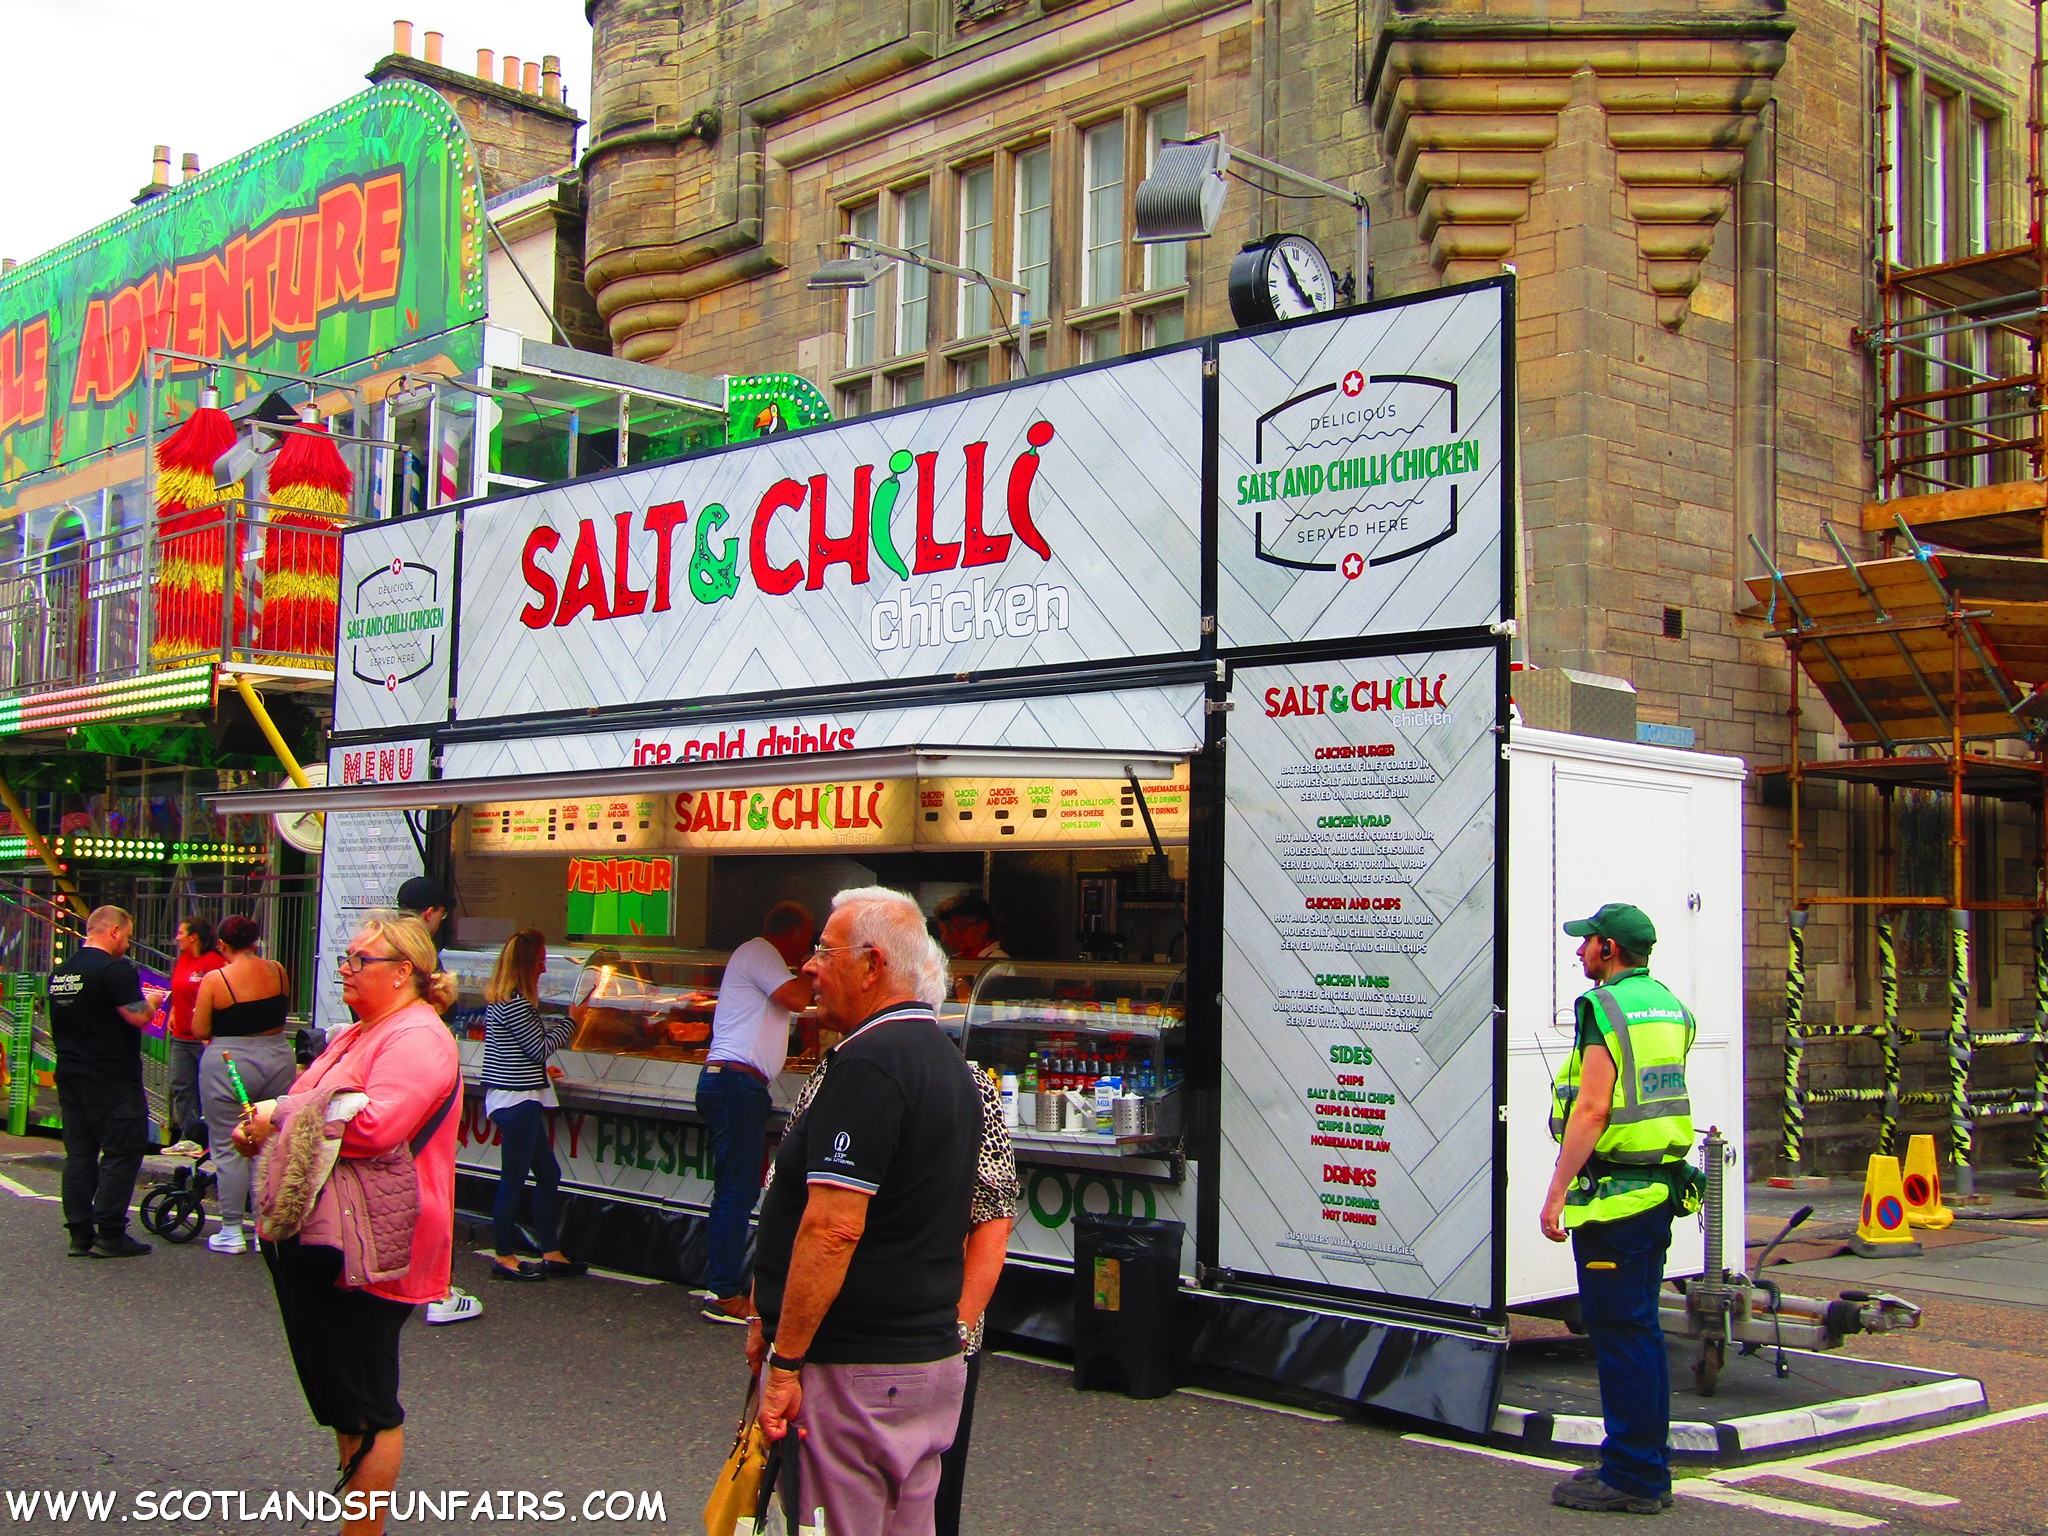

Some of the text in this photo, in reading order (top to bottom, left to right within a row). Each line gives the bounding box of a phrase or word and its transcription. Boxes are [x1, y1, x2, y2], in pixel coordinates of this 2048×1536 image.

[71, 170, 402, 404] ADVENTURE
[1310, 405, 1397, 430] DELICIOUS
[1237, 440, 1479, 505] SALT AND CHILLI CHICKEN
[519, 420, 1055, 629] SALT&CHILLI
[1297, 518, 1408, 543] SERVED HERE
[378, 582, 414, 594] DELICIOUS
[870, 577, 1070, 652] chicken
[347, 608, 444, 640] SALT AND CHILLI CHICKEN
[370, 653, 415, 667] SERVED HERE
[1265, 673, 1447, 717] SALT&CHILLI
[1393, 711, 1452, 728] chicken
[634, 739, 671, 766] ice
[757, 724, 855, 756] drinks
[1315, 744, 1395, 759] CHICKEN BURGER
[344, 748, 413, 784] MENU
[1281, 759, 1429, 775] BATTERED CHICKEN FILLET COATED IN
[1143, 785, 1178, 793] HOMEMADE
[1276, 774, 1435, 789] OUR HOUSE SALT AND CHILLI SEASONING
[921, 791, 944, 799] CHICKEN
[954, 790, 978, 798] CHICKEN
[990, 788, 1015, 796] CHICKEN
[1027, 786, 1053, 795] CHICKEN
[1301, 789, 1409, 801] SERVED ON A BRIOCHE BUN
[675, 782, 884, 832] SALT&CHILLI
[922, 800, 943, 808] BURGER
[987, 797, 1000, 806] AND
[1031, 796, 1050, 804] WINGS
[1061, 810, 1077, 818] CHIPS
[1317, 814, 1391, 828] CHICKEN WRAP
[1275, 831, 1434, 843] HOT AND SPICY CHICKEN COATED IN OUR
[1284, 845, 1424, 856] HOUSE SALT AND CHILLI SEASONING
[1281, 859, 1427, 870] SERVED ON A FRESH TORTILLA WRAP
[1296, 874, 1412, 884] WITH YOUR CHOICE OF SALAD
[1306, 898, 1401, 910] CHICKEN AND CHIPS
[1315, 974, 1389, 988] CHICKEN WINGS
[1278, 989, 1427, 1004] BATTERED CHICKEN WINGS COATED IN
[1273, 1002, 1432, 1019] OUR HOUSE SALT AND CHILLI SEASONING
[1286, 1017, 1419, 1032] SERVED WITH OR WITHOUT CHIPS
[1330, 1045, 1373, 1065] SIDES
[1337, 1074, 1364, 1086] CHIPS
[1307, 1088, 1395, 1104] SALT & CHILLI CHIPS
[1316, 1104, 1386, 1120] CHIPS & CHEESE
[1317, 1120, 1385, 1136] CHIPS & CURRY
[1311, 1135, 1391, 1153] HOMEMADE SLAW
[457, 1101, 586, 1158] QUTY
[1016, 1168, 1156, 1229] OOD
[1323, 1164, 1377, 1187] DRINKS
[1320, 1193, 1380, 1210] COLD DRINKS
[1322, 1209, 1377, 1226] HOT DRINKS
[1285, 1230, 1329, 1245] CUSTOMERS
[1330, 1236, 1351, 1247] WITH
[1351, 1238, 1372, 1250] FOOD
[1373, 1242, 1414, 1255] ALLERGIES
